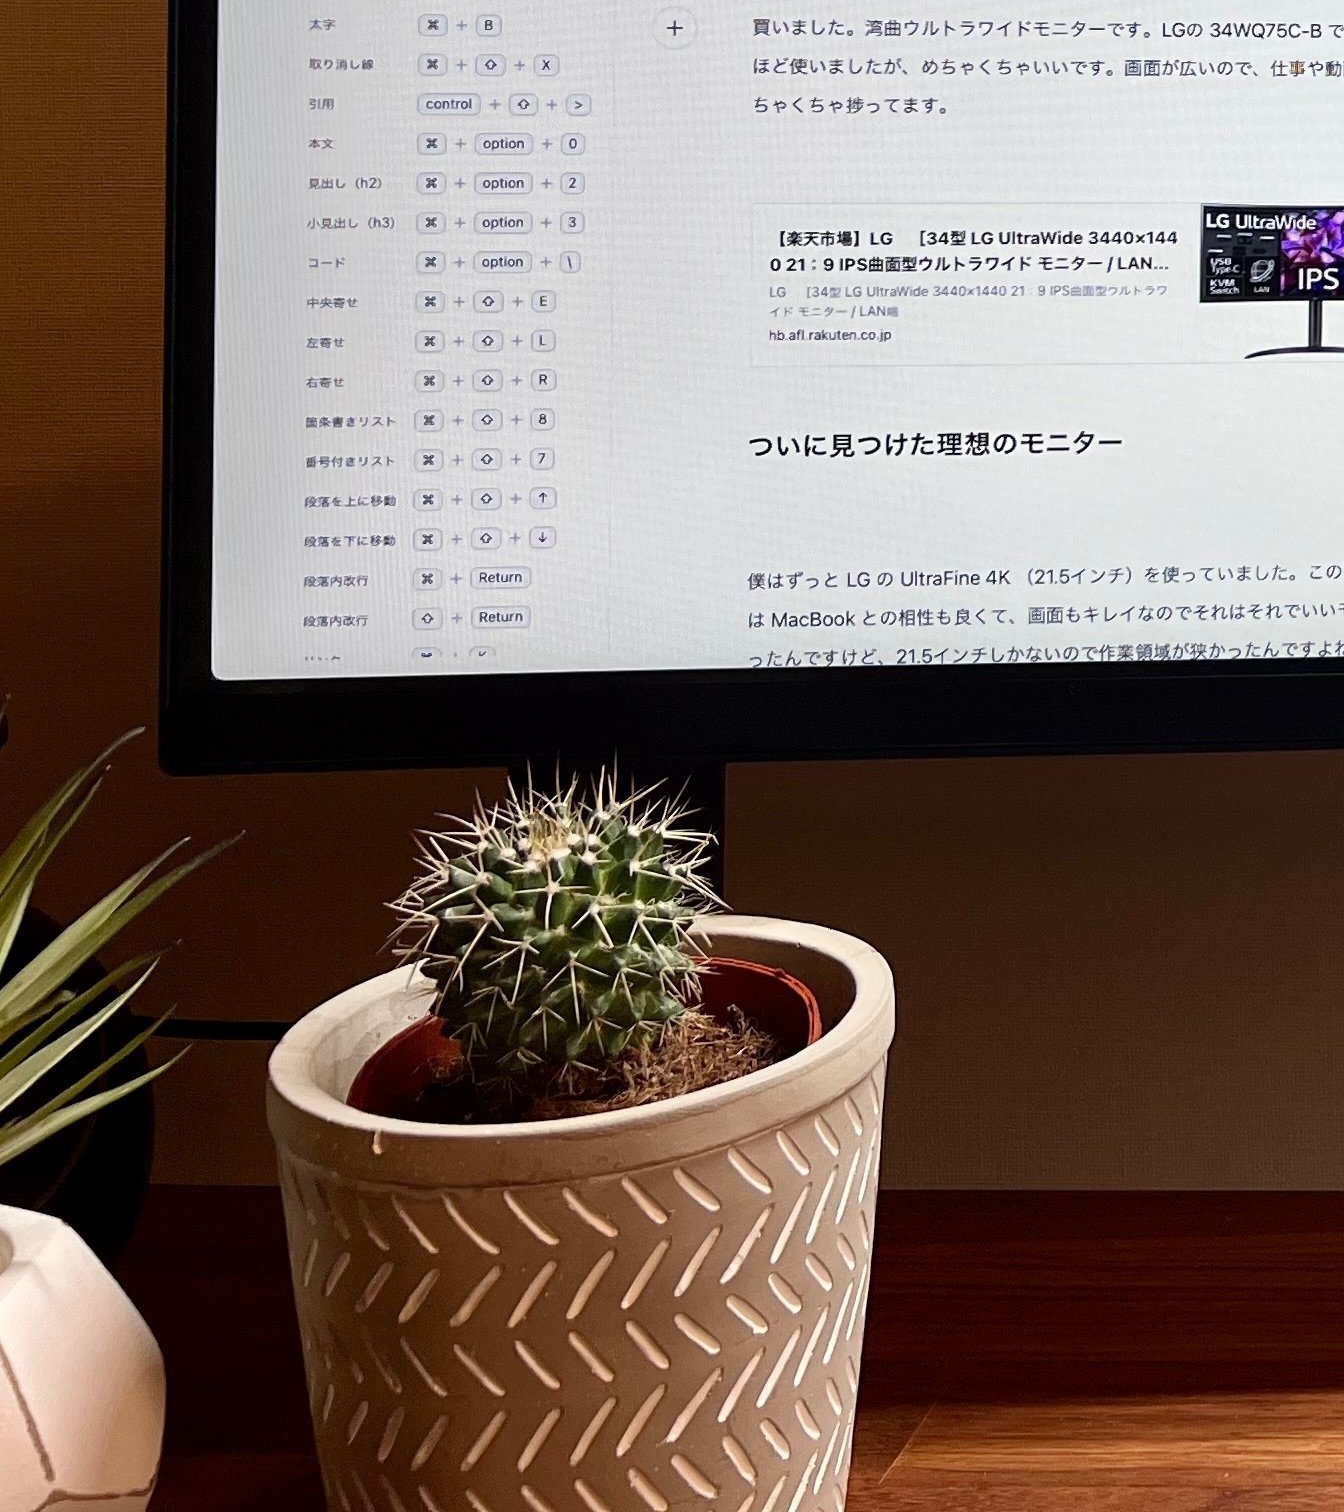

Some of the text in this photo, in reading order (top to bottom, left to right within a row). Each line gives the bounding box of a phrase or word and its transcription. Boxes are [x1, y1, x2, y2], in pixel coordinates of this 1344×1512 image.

[426, 99, 472, 109] control
[483, 139, 524, 150] option
[1206, 213, 1317, 230] LG UltraWide
[1298, 267, 1340, 290] IPS
[770, 329, 891, 342] hb.afl.rakuten.co.jp
[749, 431, 1121, 457] ついに見つけた理想のモニター
[480, 572, 522, 583] Return
